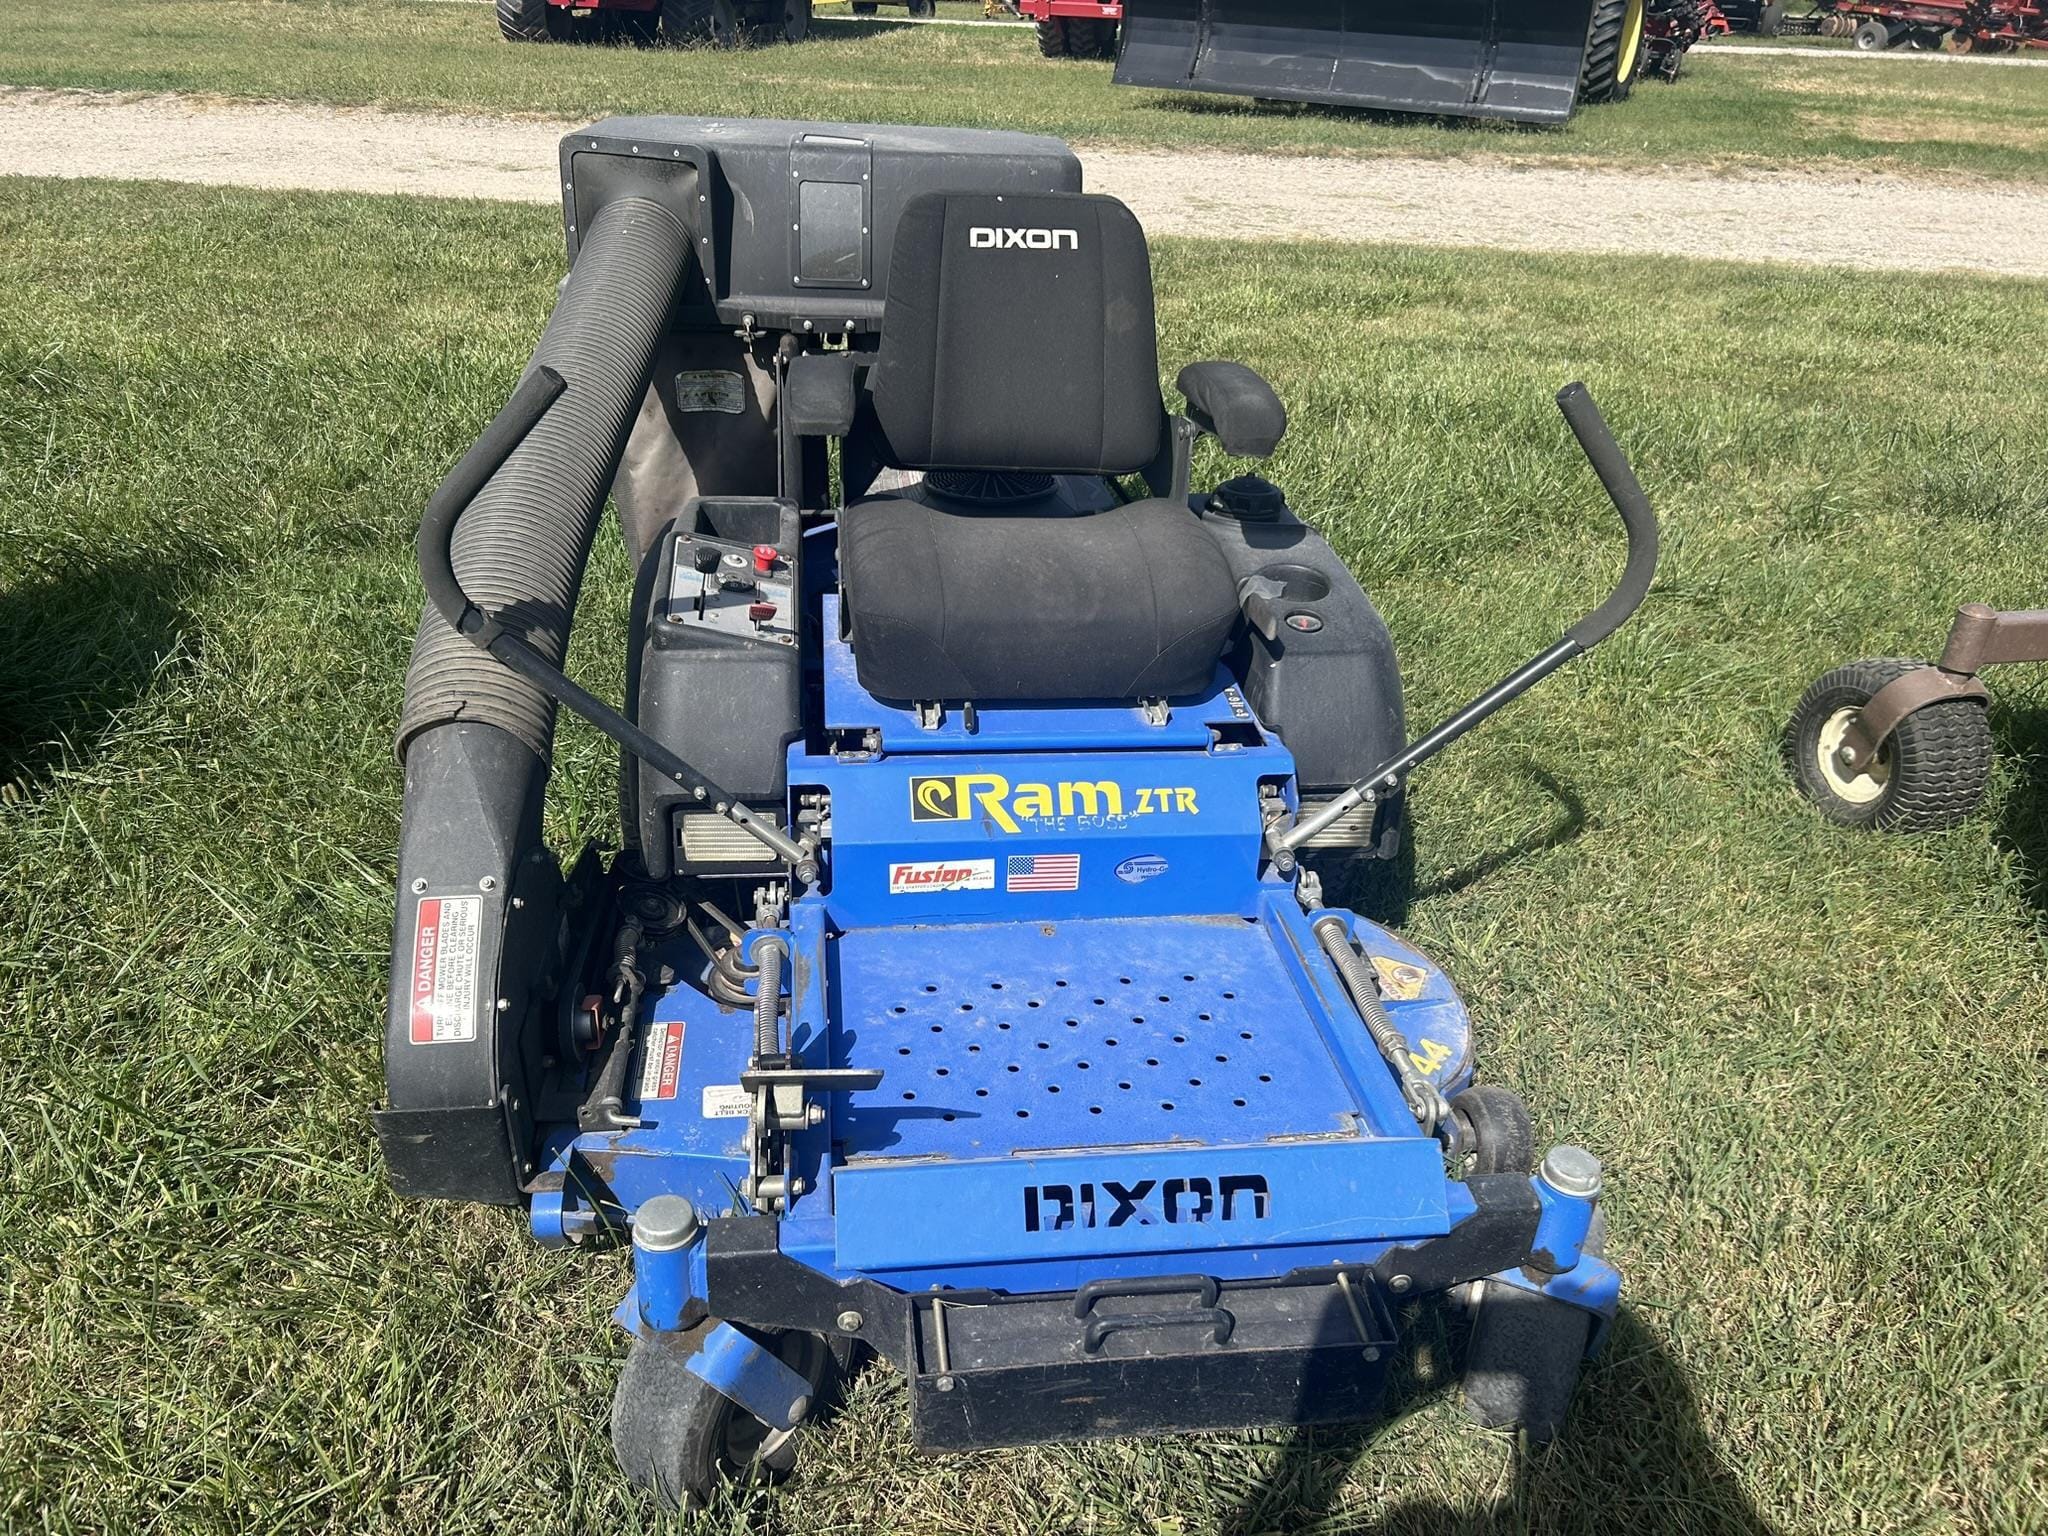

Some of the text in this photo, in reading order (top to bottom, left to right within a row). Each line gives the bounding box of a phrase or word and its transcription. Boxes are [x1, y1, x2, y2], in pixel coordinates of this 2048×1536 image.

[969, 227, 1078, 250] DIXON
[954, 774, 1200, 833] Ram ZTR
[892, 864, 972, 885] Fusion
[443, 902, 451, 920] AND
[459, 900, 468, 938] SERIOUS
[440, 921, 451, 955] BLADES
[449, 911, 459, 954] CLEARING
[457, 939, 465, 952] OR
[417, 927, 436, 993] DANGER
[438, 957, 447, 991] MOWER
[446, 955, 456, 991] BEFORE
[455, 953, 465, 983] CHUTE
[463, 924, 475, 1010] INJURY WILL OCCUR
[662, 1045, 680, 1086] DANGER
[1408, 1038, 1453, 1076] 44
[1023, 1174, 1270, 1232] DIXON
